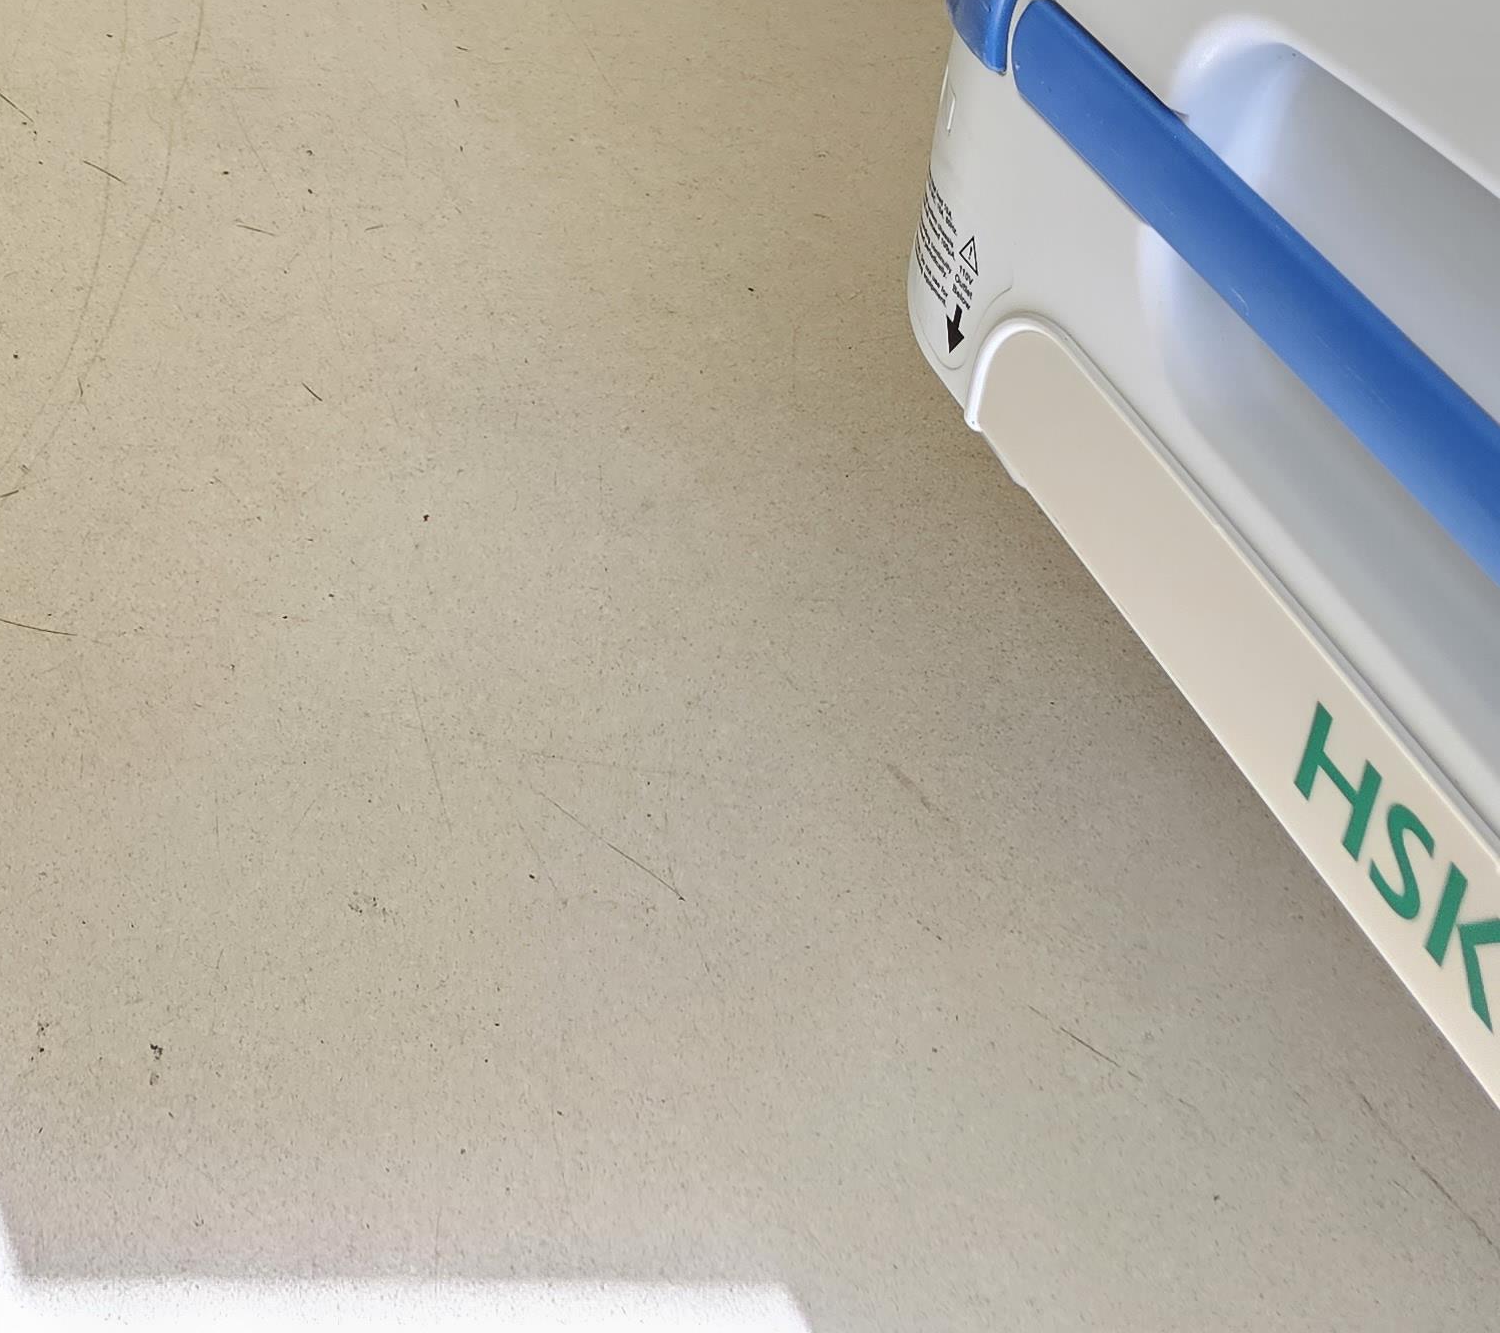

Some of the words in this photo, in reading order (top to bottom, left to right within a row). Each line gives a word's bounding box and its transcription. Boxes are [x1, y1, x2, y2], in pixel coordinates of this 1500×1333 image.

[954, 273, 973, 300] Outlet
[959, 264, 974, 286] 110V
[952, 283, 970, 310] Below
[1293, 701, 1500, 1034] HSK
